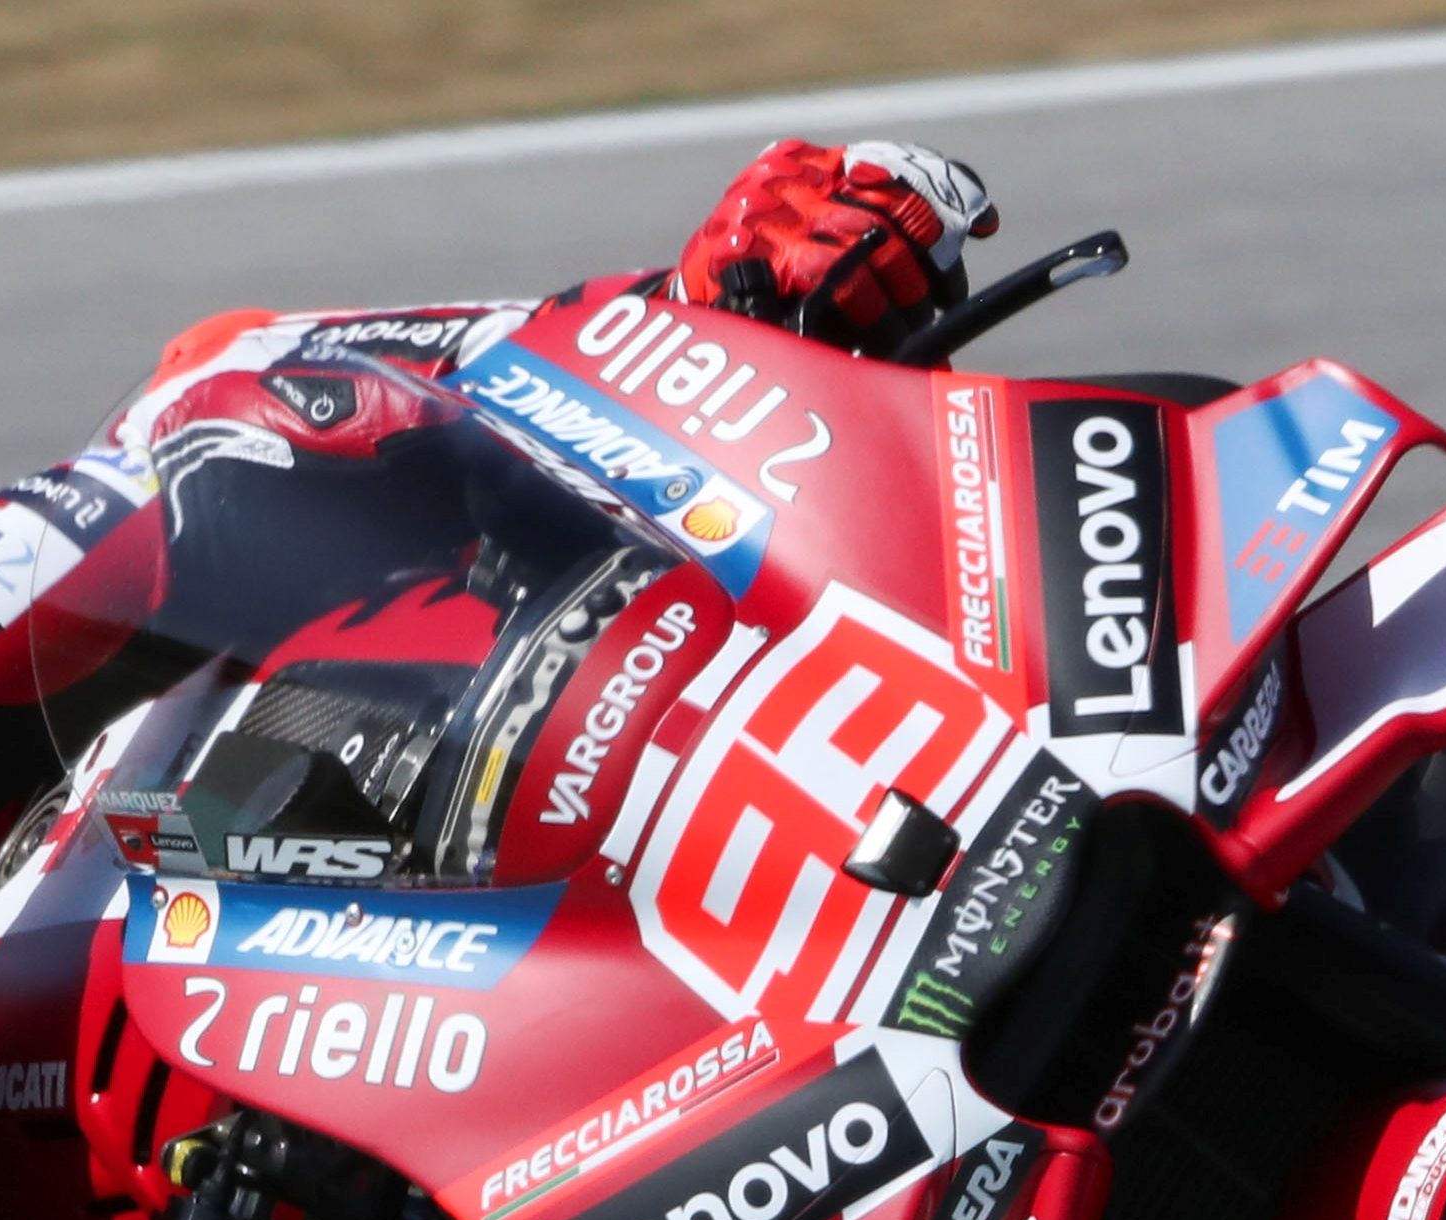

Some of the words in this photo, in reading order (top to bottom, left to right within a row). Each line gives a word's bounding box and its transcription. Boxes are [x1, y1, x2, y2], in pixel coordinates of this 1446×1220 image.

[945, 387, 995, 670] FRECCIAROSSA
[1274, 418, 1387, 517] TIM
[1071, 415, 1154, 718] Lenovo
[538, 599, 697, 827] VARGROUP
[93, 790, 183, 813] MARQUEZ
[151, 834, 195, 850] Lenovo
[226, 834, 392, 879] WRS
[933, 774, 1082, 978] MONSTER
[989, 813, 1085, 955] ENERGY
[236, 906, 500, 973] ADVANCE
[237, 983, 488, 1094] riello
[480, 1020, 776, 1211] FRECCIAROSSA
